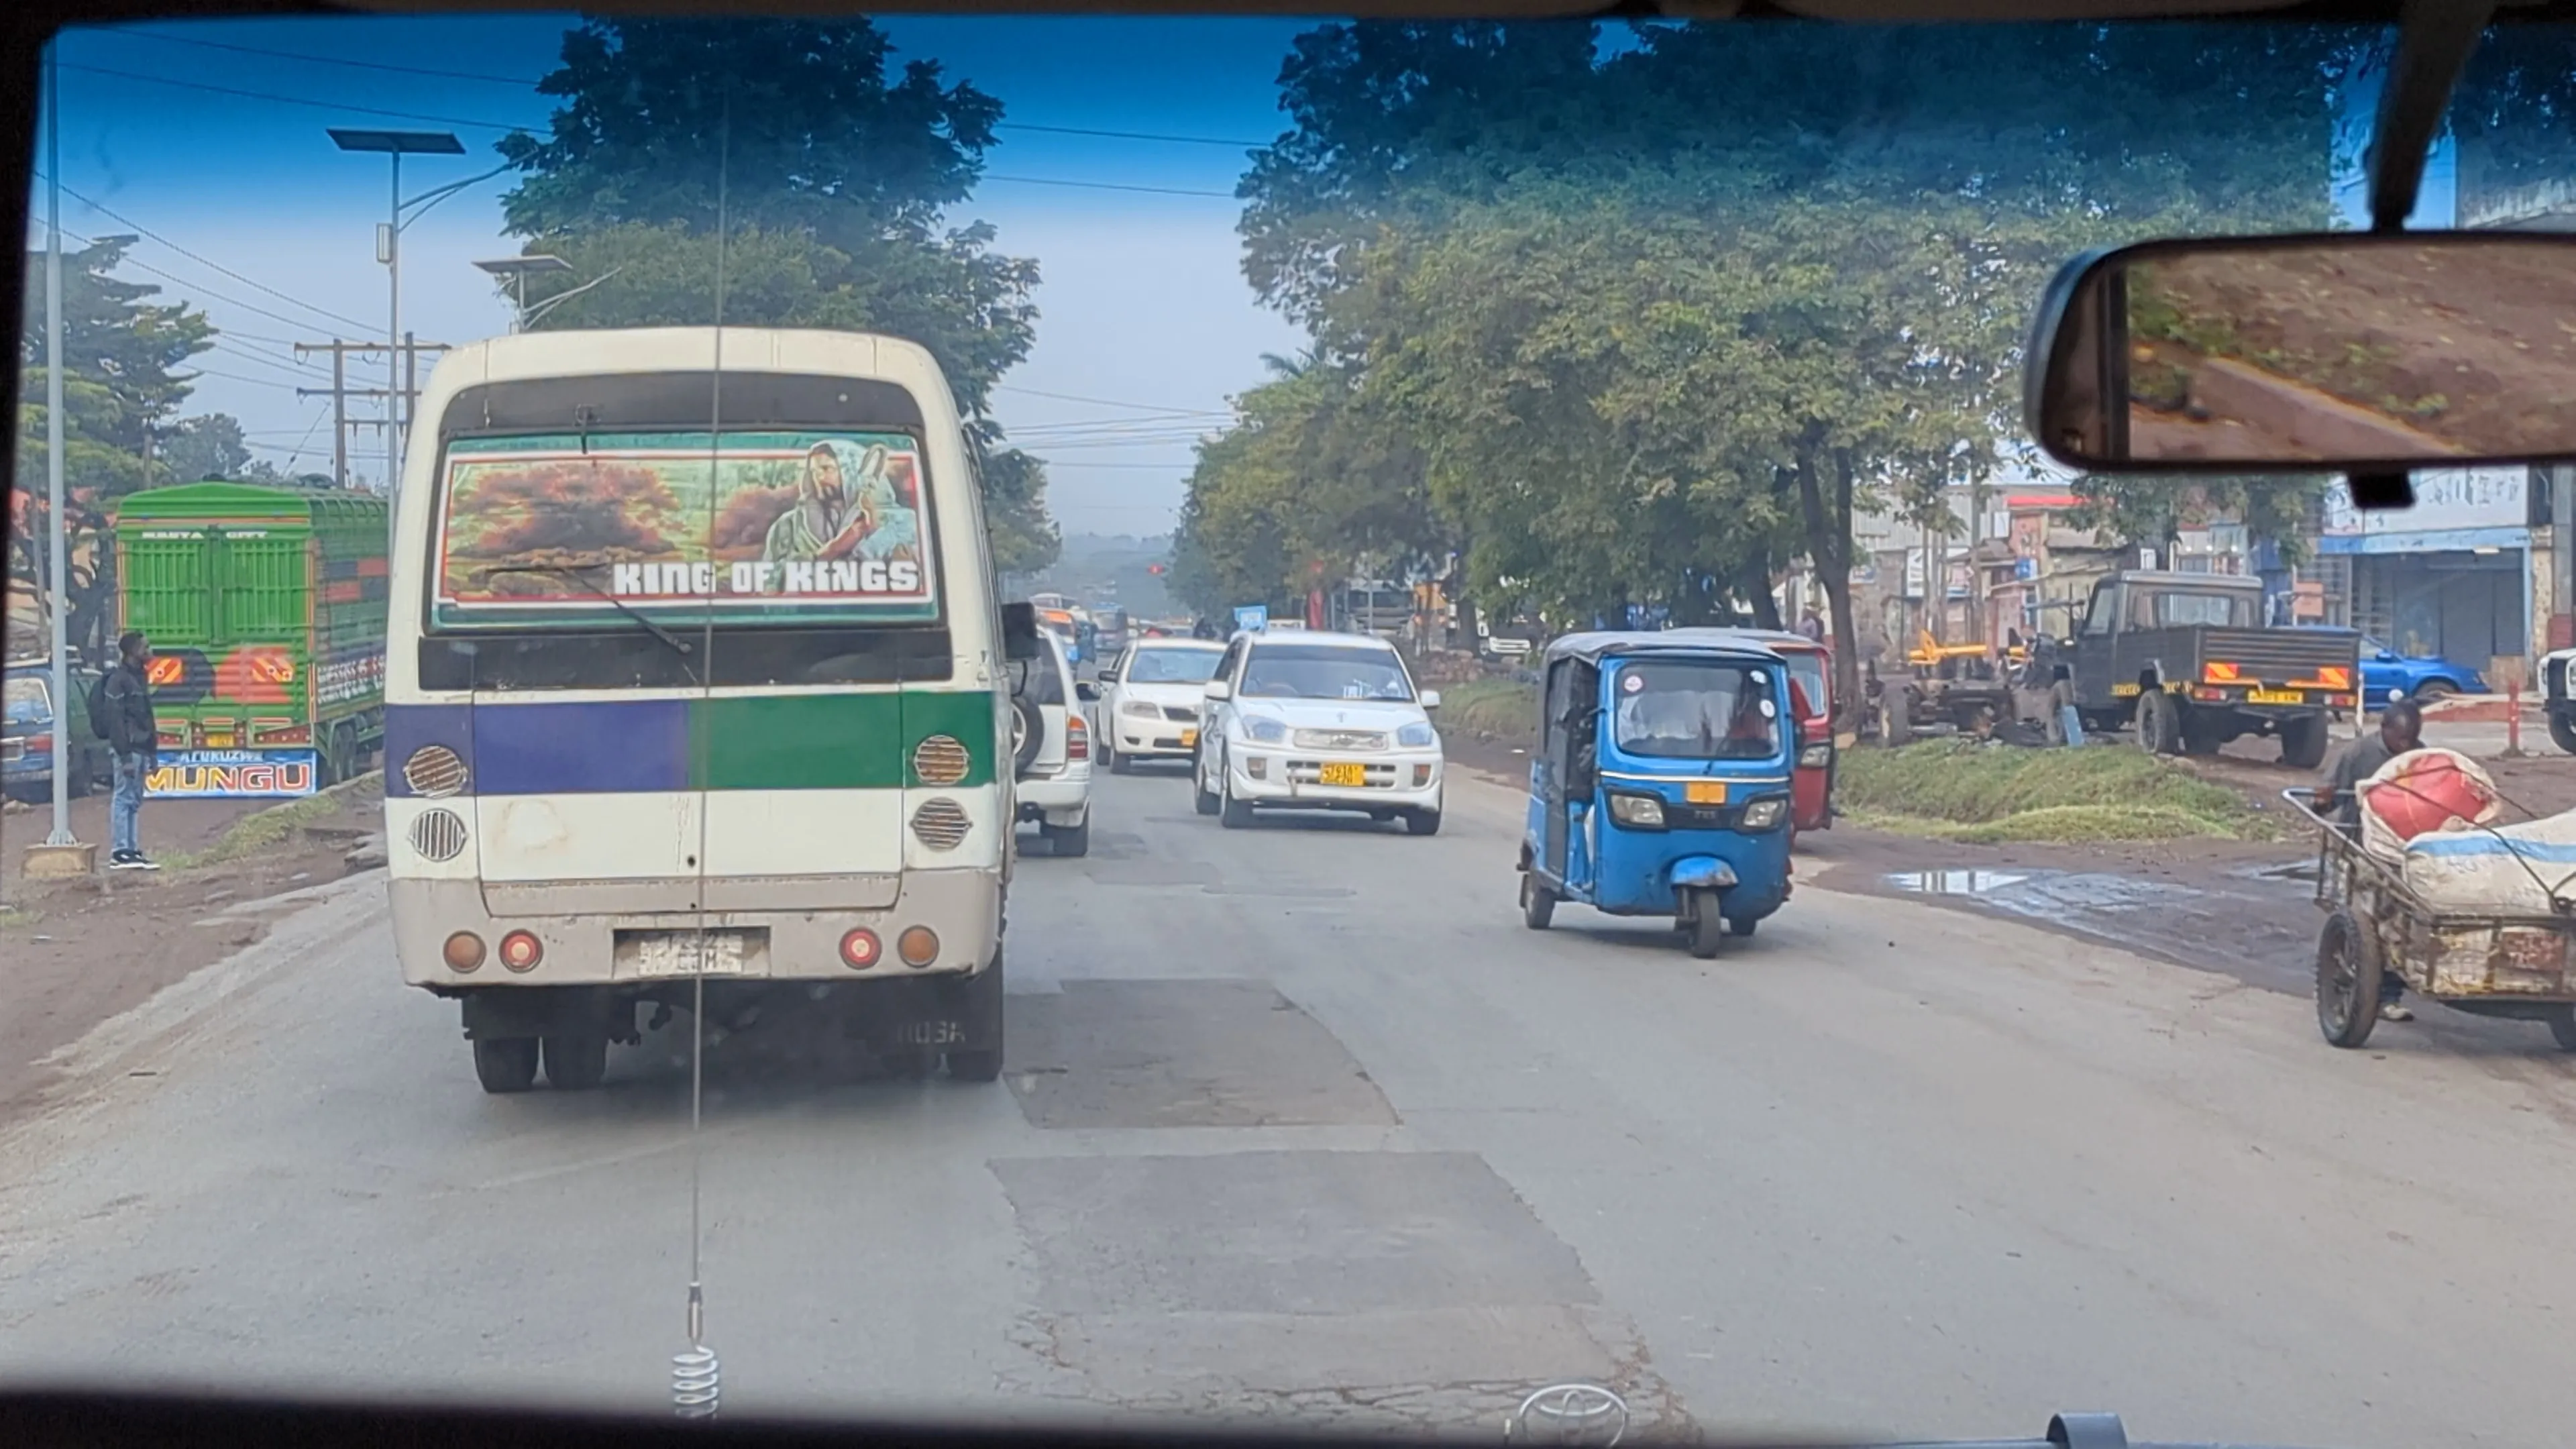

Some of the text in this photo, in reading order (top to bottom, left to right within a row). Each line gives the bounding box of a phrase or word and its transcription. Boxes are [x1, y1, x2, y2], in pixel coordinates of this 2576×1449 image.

[613, 561, 919, 594] KING OF KINGS
[145, 764, 309, 792] MUNGU
